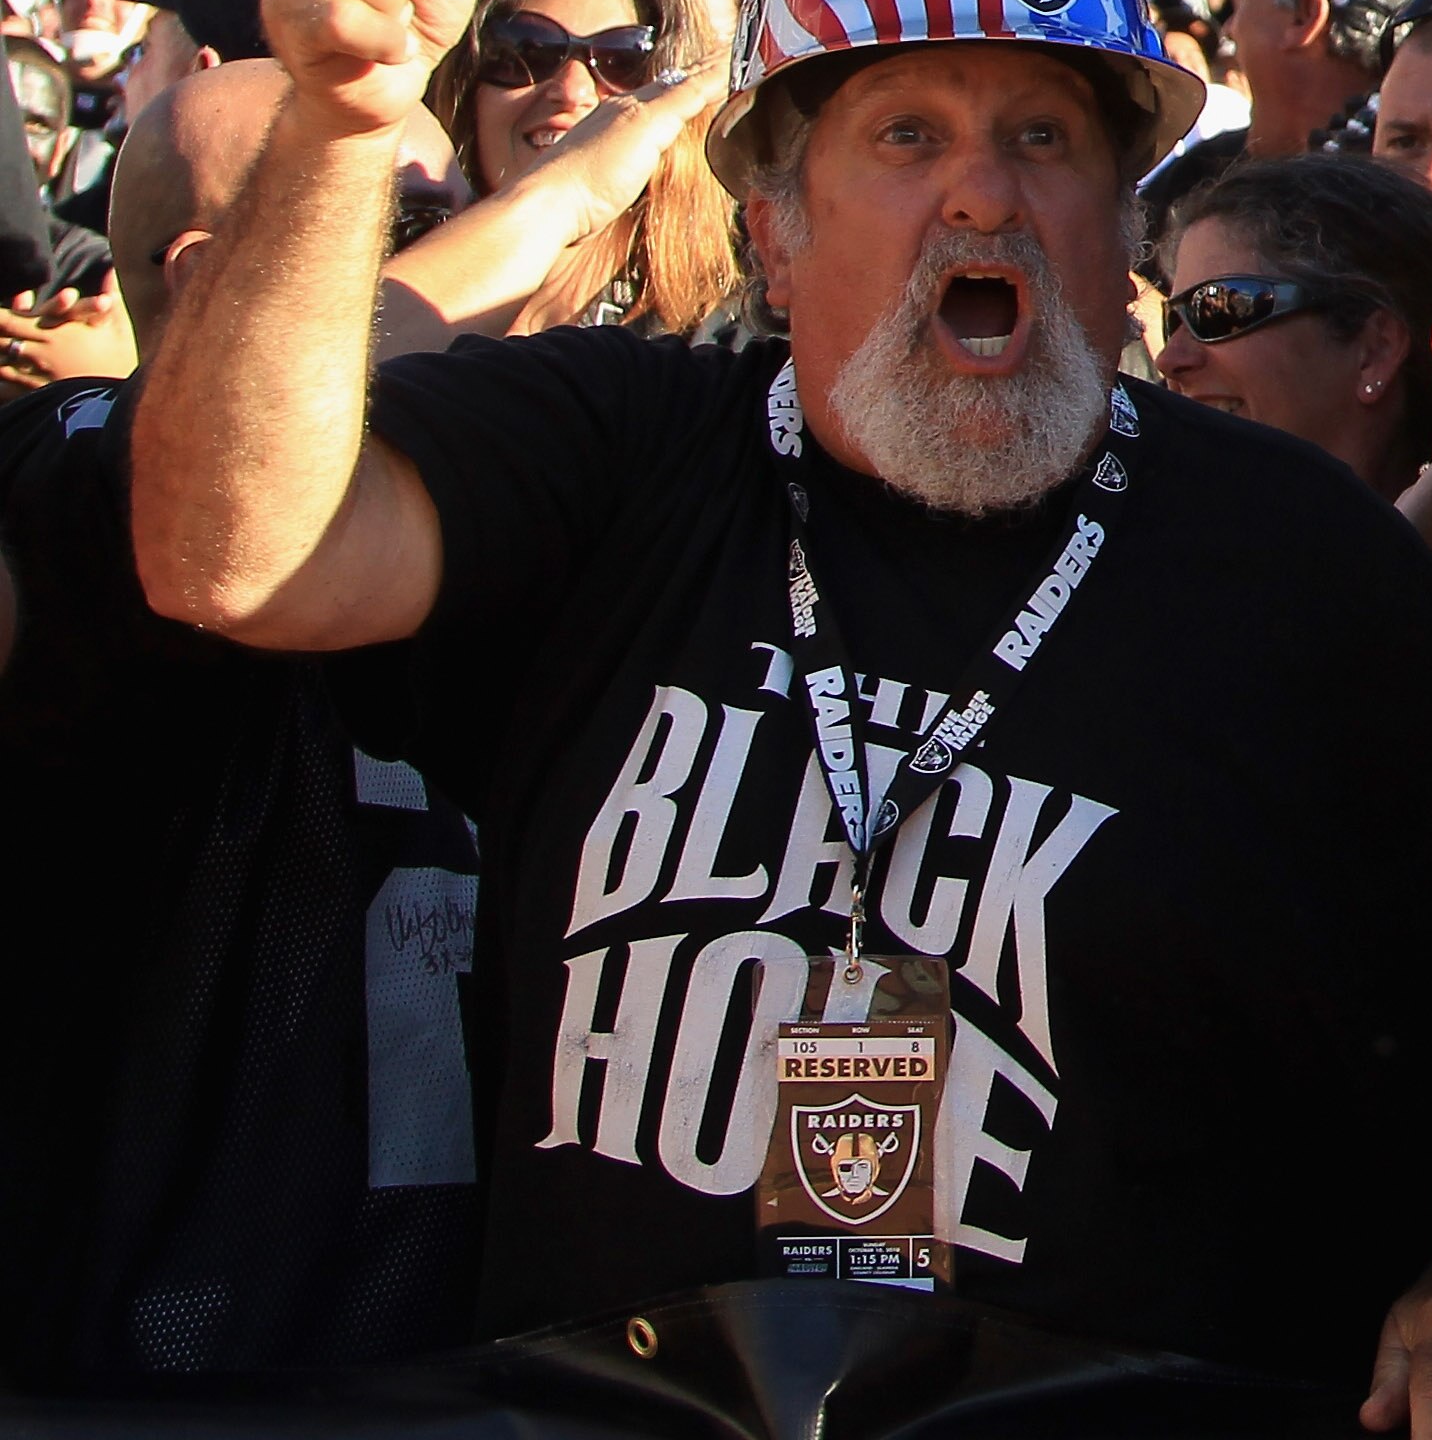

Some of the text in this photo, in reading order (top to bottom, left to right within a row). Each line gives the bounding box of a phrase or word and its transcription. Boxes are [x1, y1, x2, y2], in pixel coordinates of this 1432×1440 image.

[993, 513, 1105, 672] RAIDERS
[932, 708, 961, 739] THE
[943, 690, 991, 741] RAIDER
[943, 702, 996, 751] IMAGE
[563, 683, 1119, 1080] BLACK
[790, 1026, 924, 1034] SECTION ROW SEAT
[792, 1041, 920, 1054] 105 1 8
[784, 1057, 929, 1079] RESERVED
[807, 1112, 904, 1130] RAIDERS
[783, 1245, 833, 1256] RAIDERS
[850, 1254, 900, 1264] 1:15 PM
[917, 1248, 930, 1268] 5
